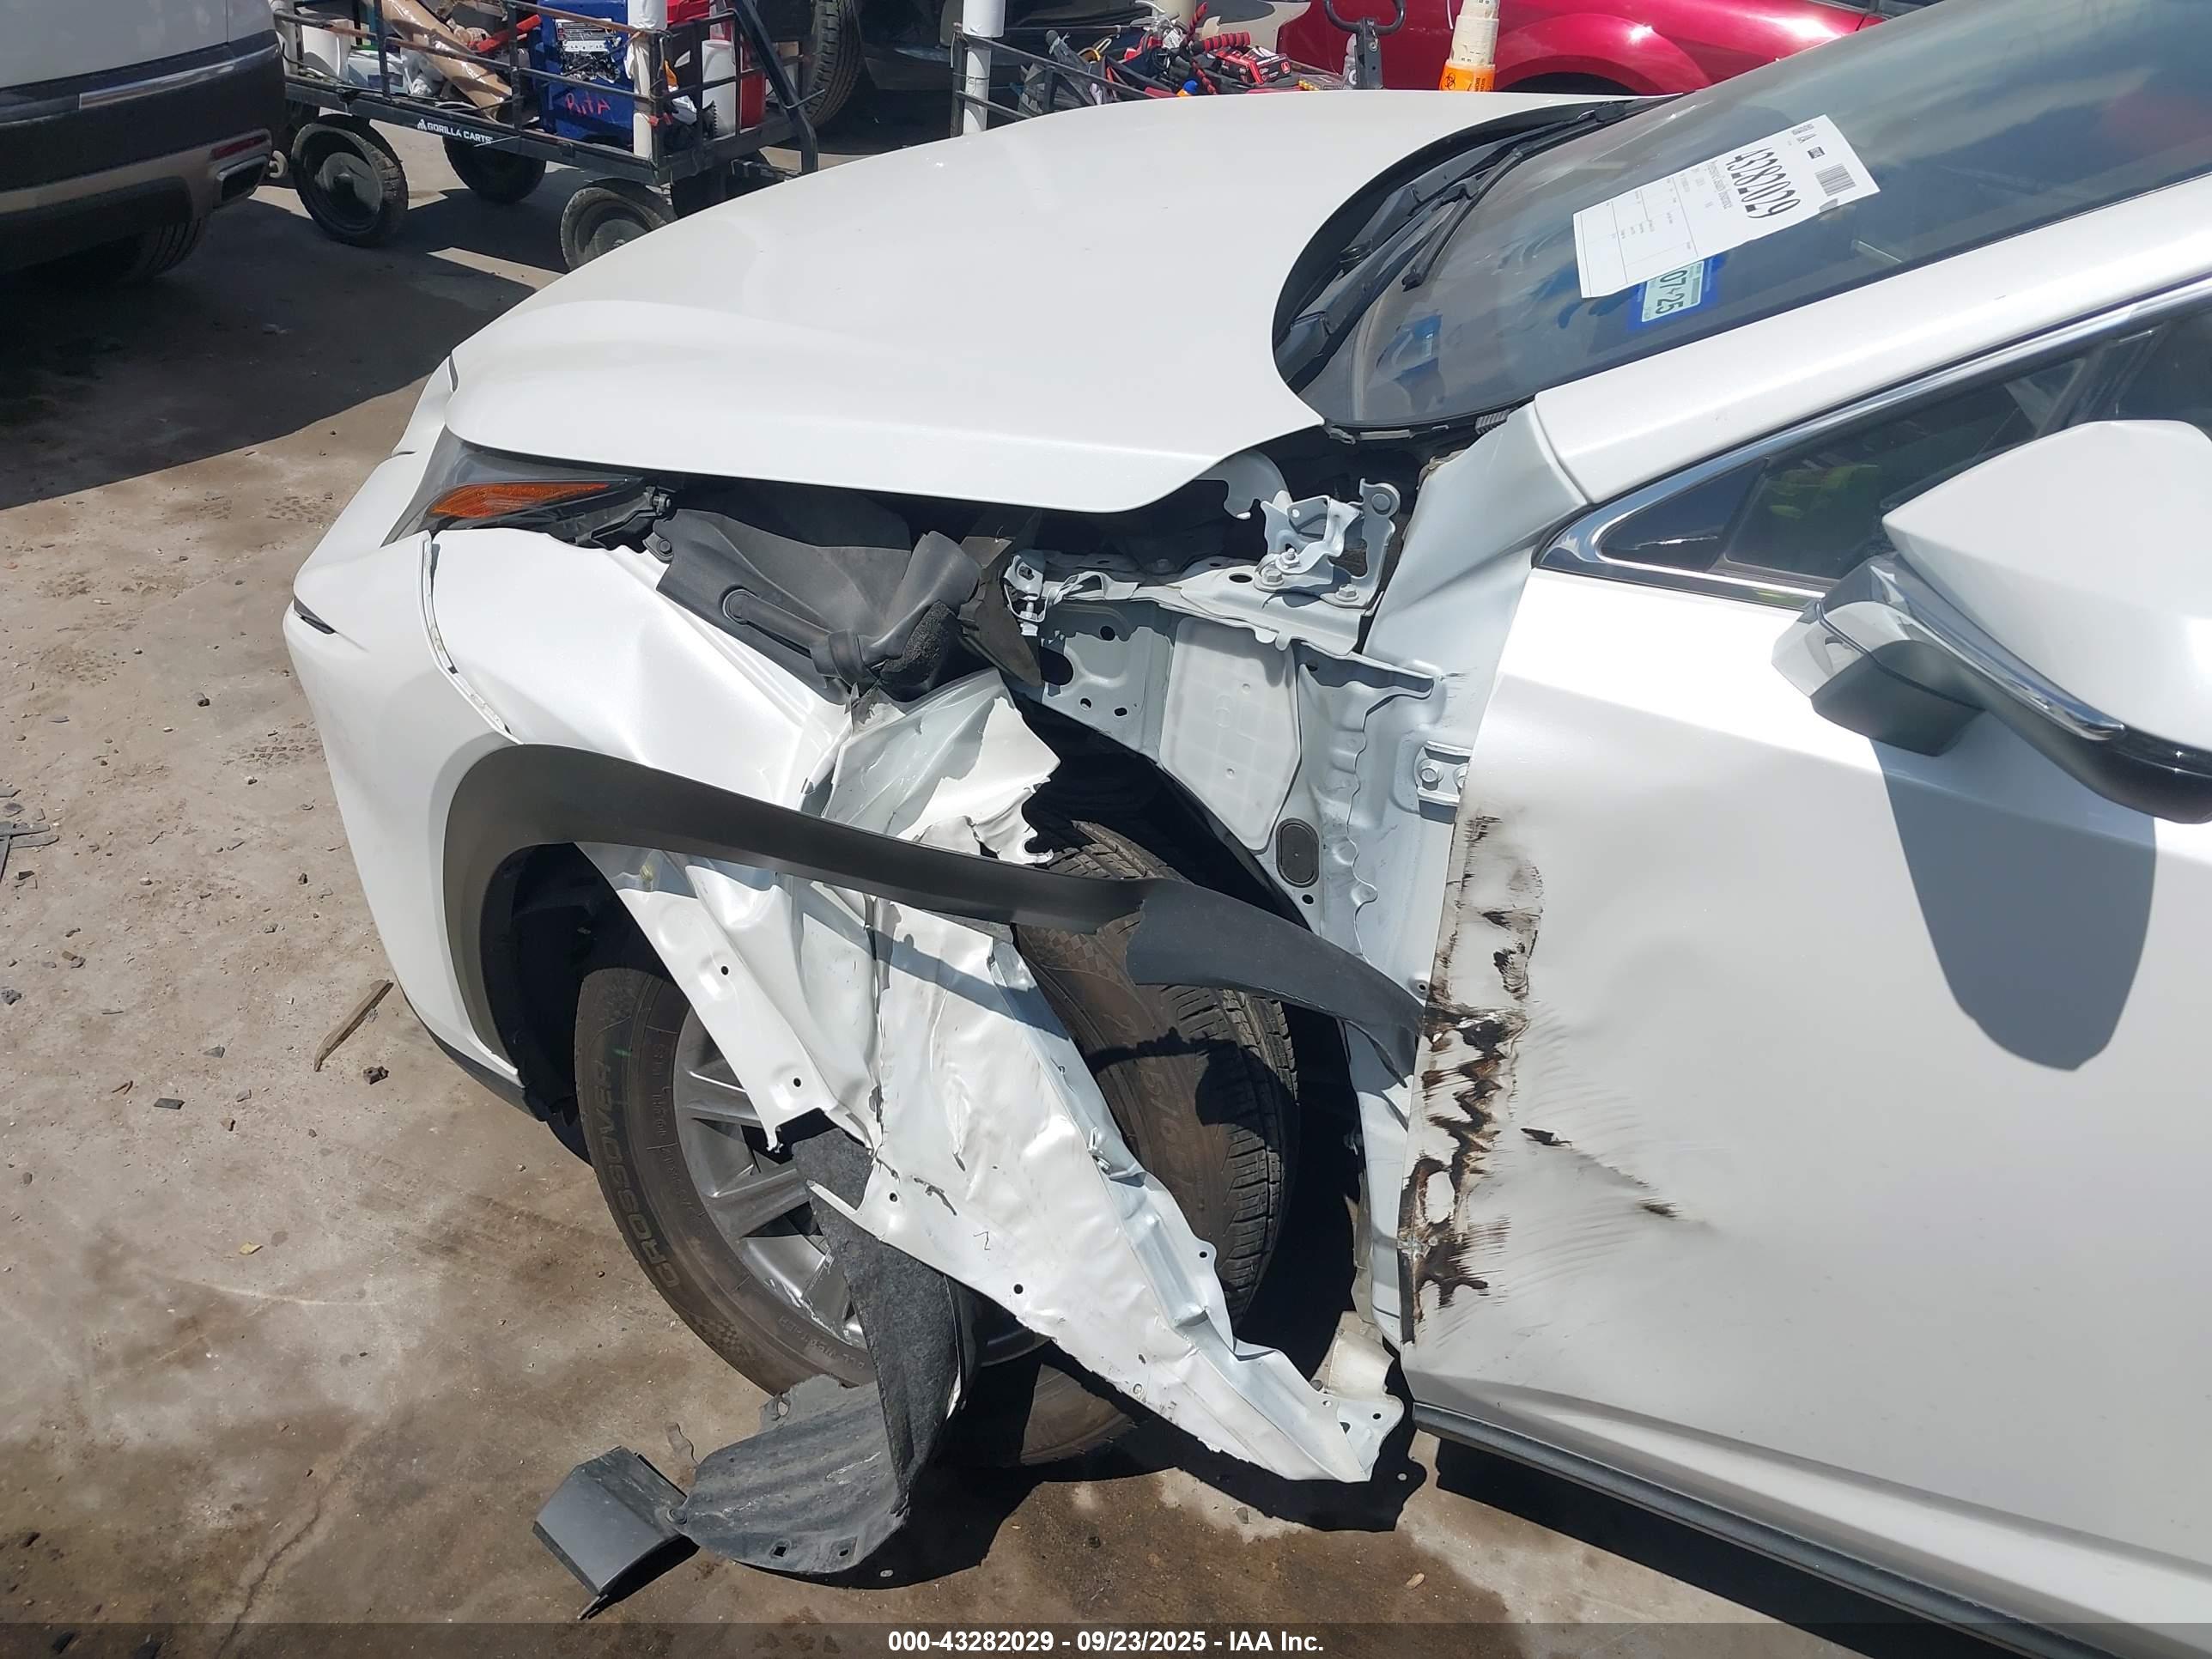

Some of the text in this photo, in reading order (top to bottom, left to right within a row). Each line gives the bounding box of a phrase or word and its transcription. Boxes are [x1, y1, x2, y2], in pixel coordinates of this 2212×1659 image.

[427, 122, 462, 137] GORILLA
[1726, 147, 1801, 218] 43282029
[1655, 270, 1688, 314] 07 25
